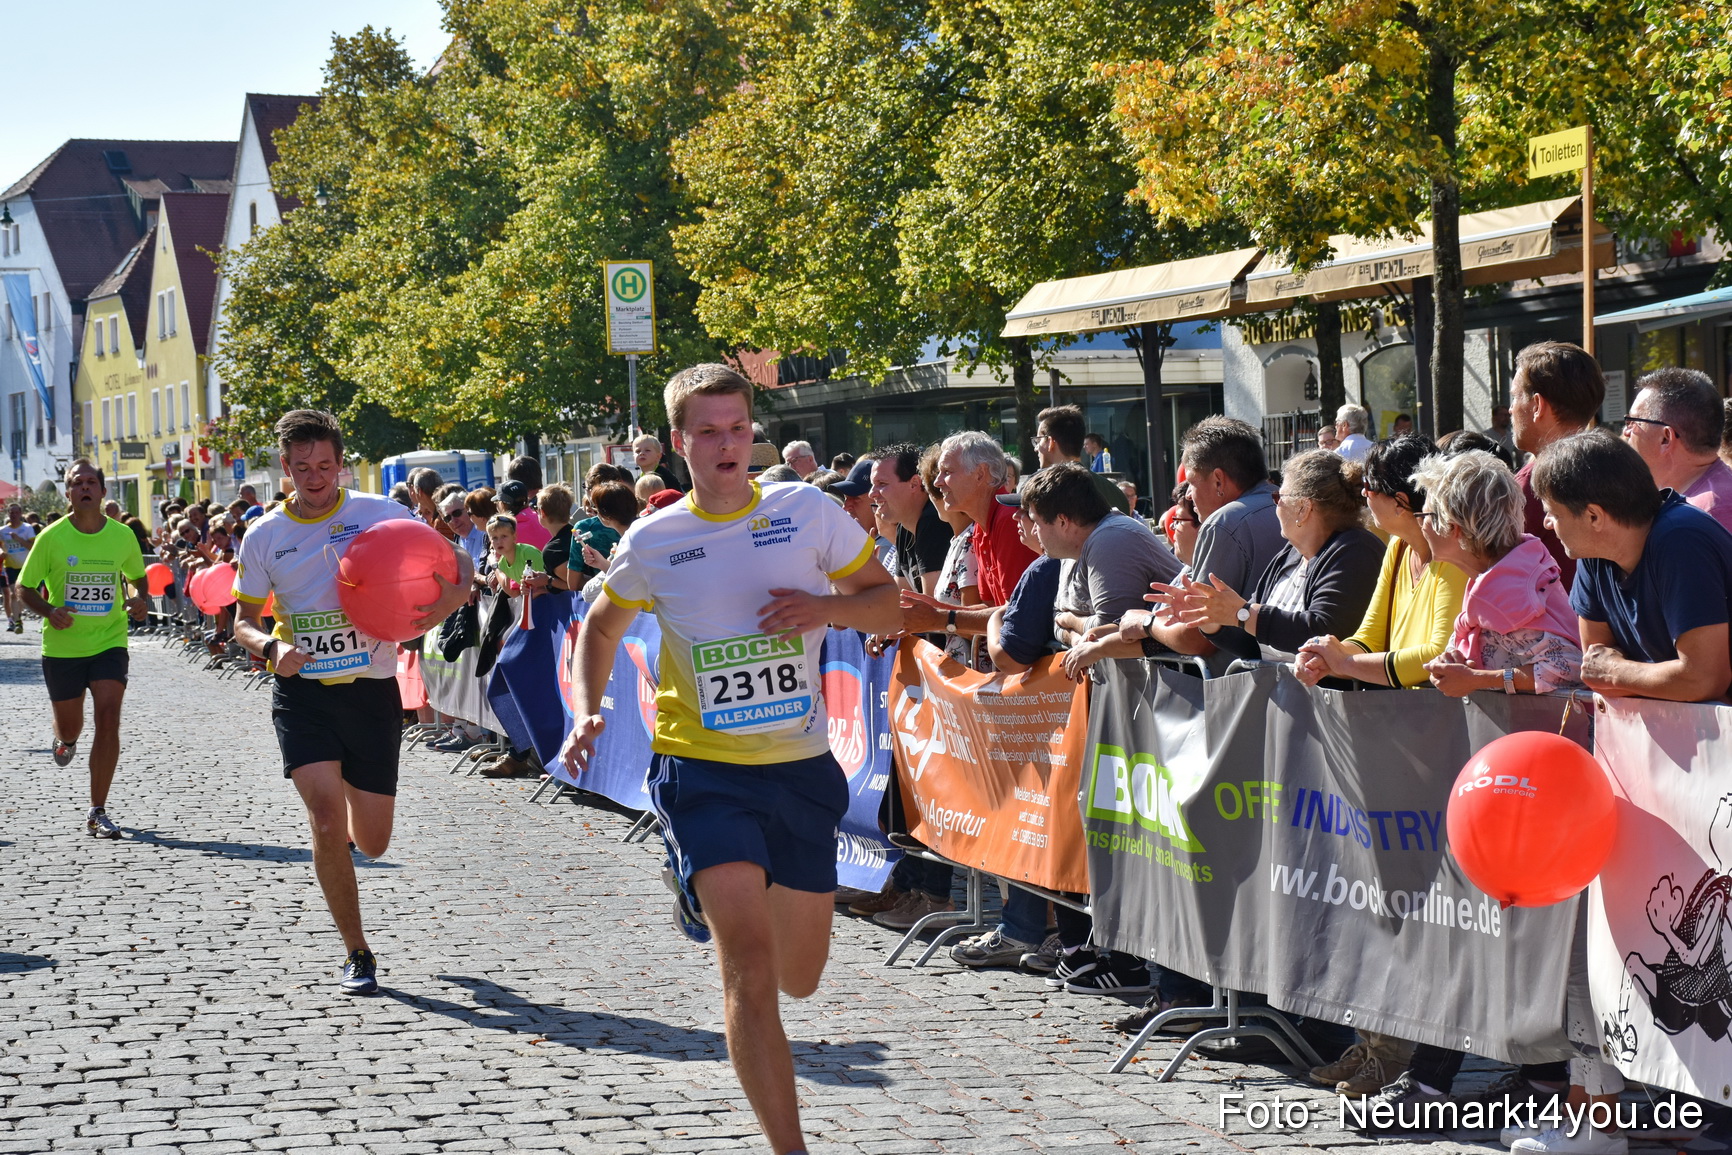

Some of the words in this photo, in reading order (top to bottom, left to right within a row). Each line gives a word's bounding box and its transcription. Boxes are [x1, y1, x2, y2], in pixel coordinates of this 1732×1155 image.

[1540, 143, 1582, 164] Toiletten
[620, 275, 638, 295] H
[331, 524, 344, 534] 20
[751, 518, 771, 531] 20
[772, 518, 791, 526] JAHRE
[752, 525, 798, 539] Neumarkter
[754, 535, 792, 548] Stadtlauf
[670, 547, 705, 563] BOCK
[69, 573, 112, 584] BOCK
[70, 587, 110, 601] 2236
[701, 635, 795, 668] BOCK
[304, 656, 363, 671] CHRISTOPH
[710, 664, 798, 705] 2318
[1004, 693, 1039, 706] moderner
[1039, 692, 1072, 703] Partner
[714, 701, 804, 726] ALEXANDER
[991, 711, 1027, 728] Konzeption
[1028, 710, 1042, 723] und
[1002, 730, 1034, 747] Projekte
[1034, 733, 1048, 743] was
[1026, 749, 1037, 761] und
[1493, 786, 1536, 798] energie
[1083, 825, 1143, 856] inspired
[1145, 835, 1153, 865] by
